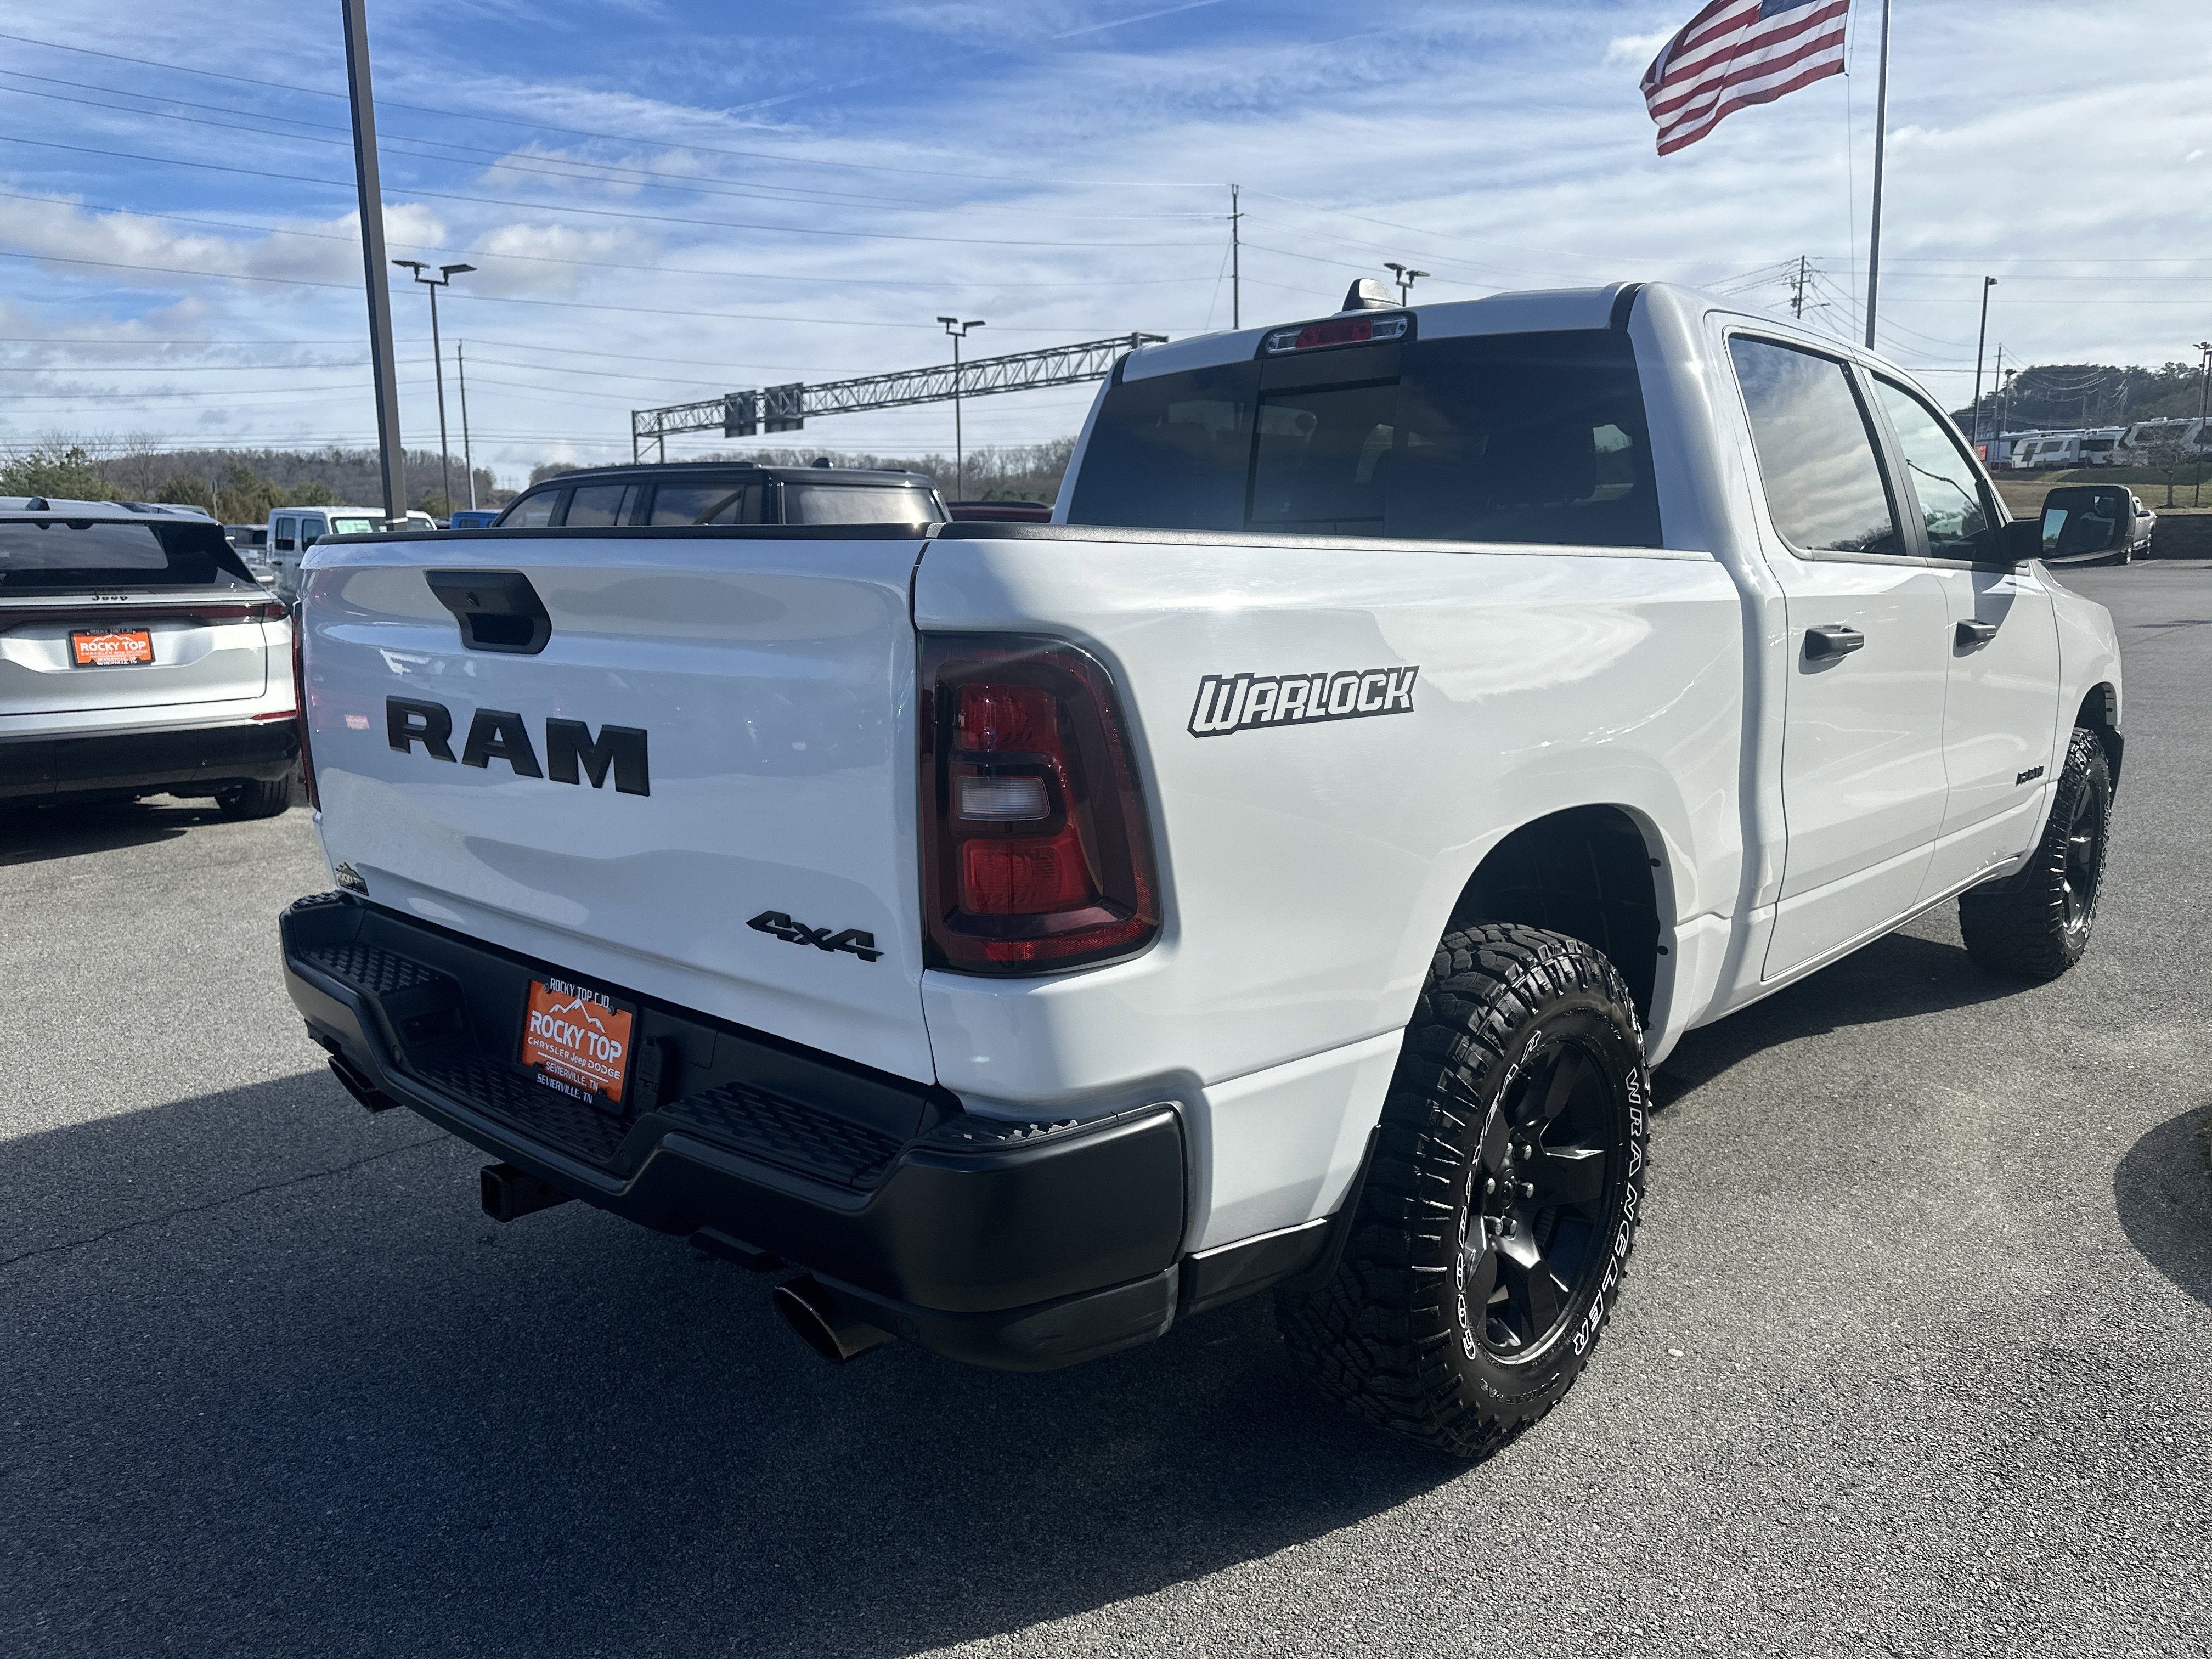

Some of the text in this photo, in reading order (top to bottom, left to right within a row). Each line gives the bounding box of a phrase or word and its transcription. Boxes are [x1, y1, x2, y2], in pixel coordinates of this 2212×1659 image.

[80, 640, 146, 651] ROCKY TOP
[1187, 666, 1420, 738] WARLOCK
[386, 695, 650, 797] RAM
[550, 978, 610, 1008] ROCKY TOP CJD
[528, 1036, 621, 1080] CHRYSLER Jeep DODGE
[529, 1010, 622, 1063] ROCKY TOP
[537, 1073, 593, 1104] SEVIERVILLE, TN
[546, 1062, 599, 1091] SEVIERVILLE, TN
[1573, 1067, 1642, 1356] WRANGLER
